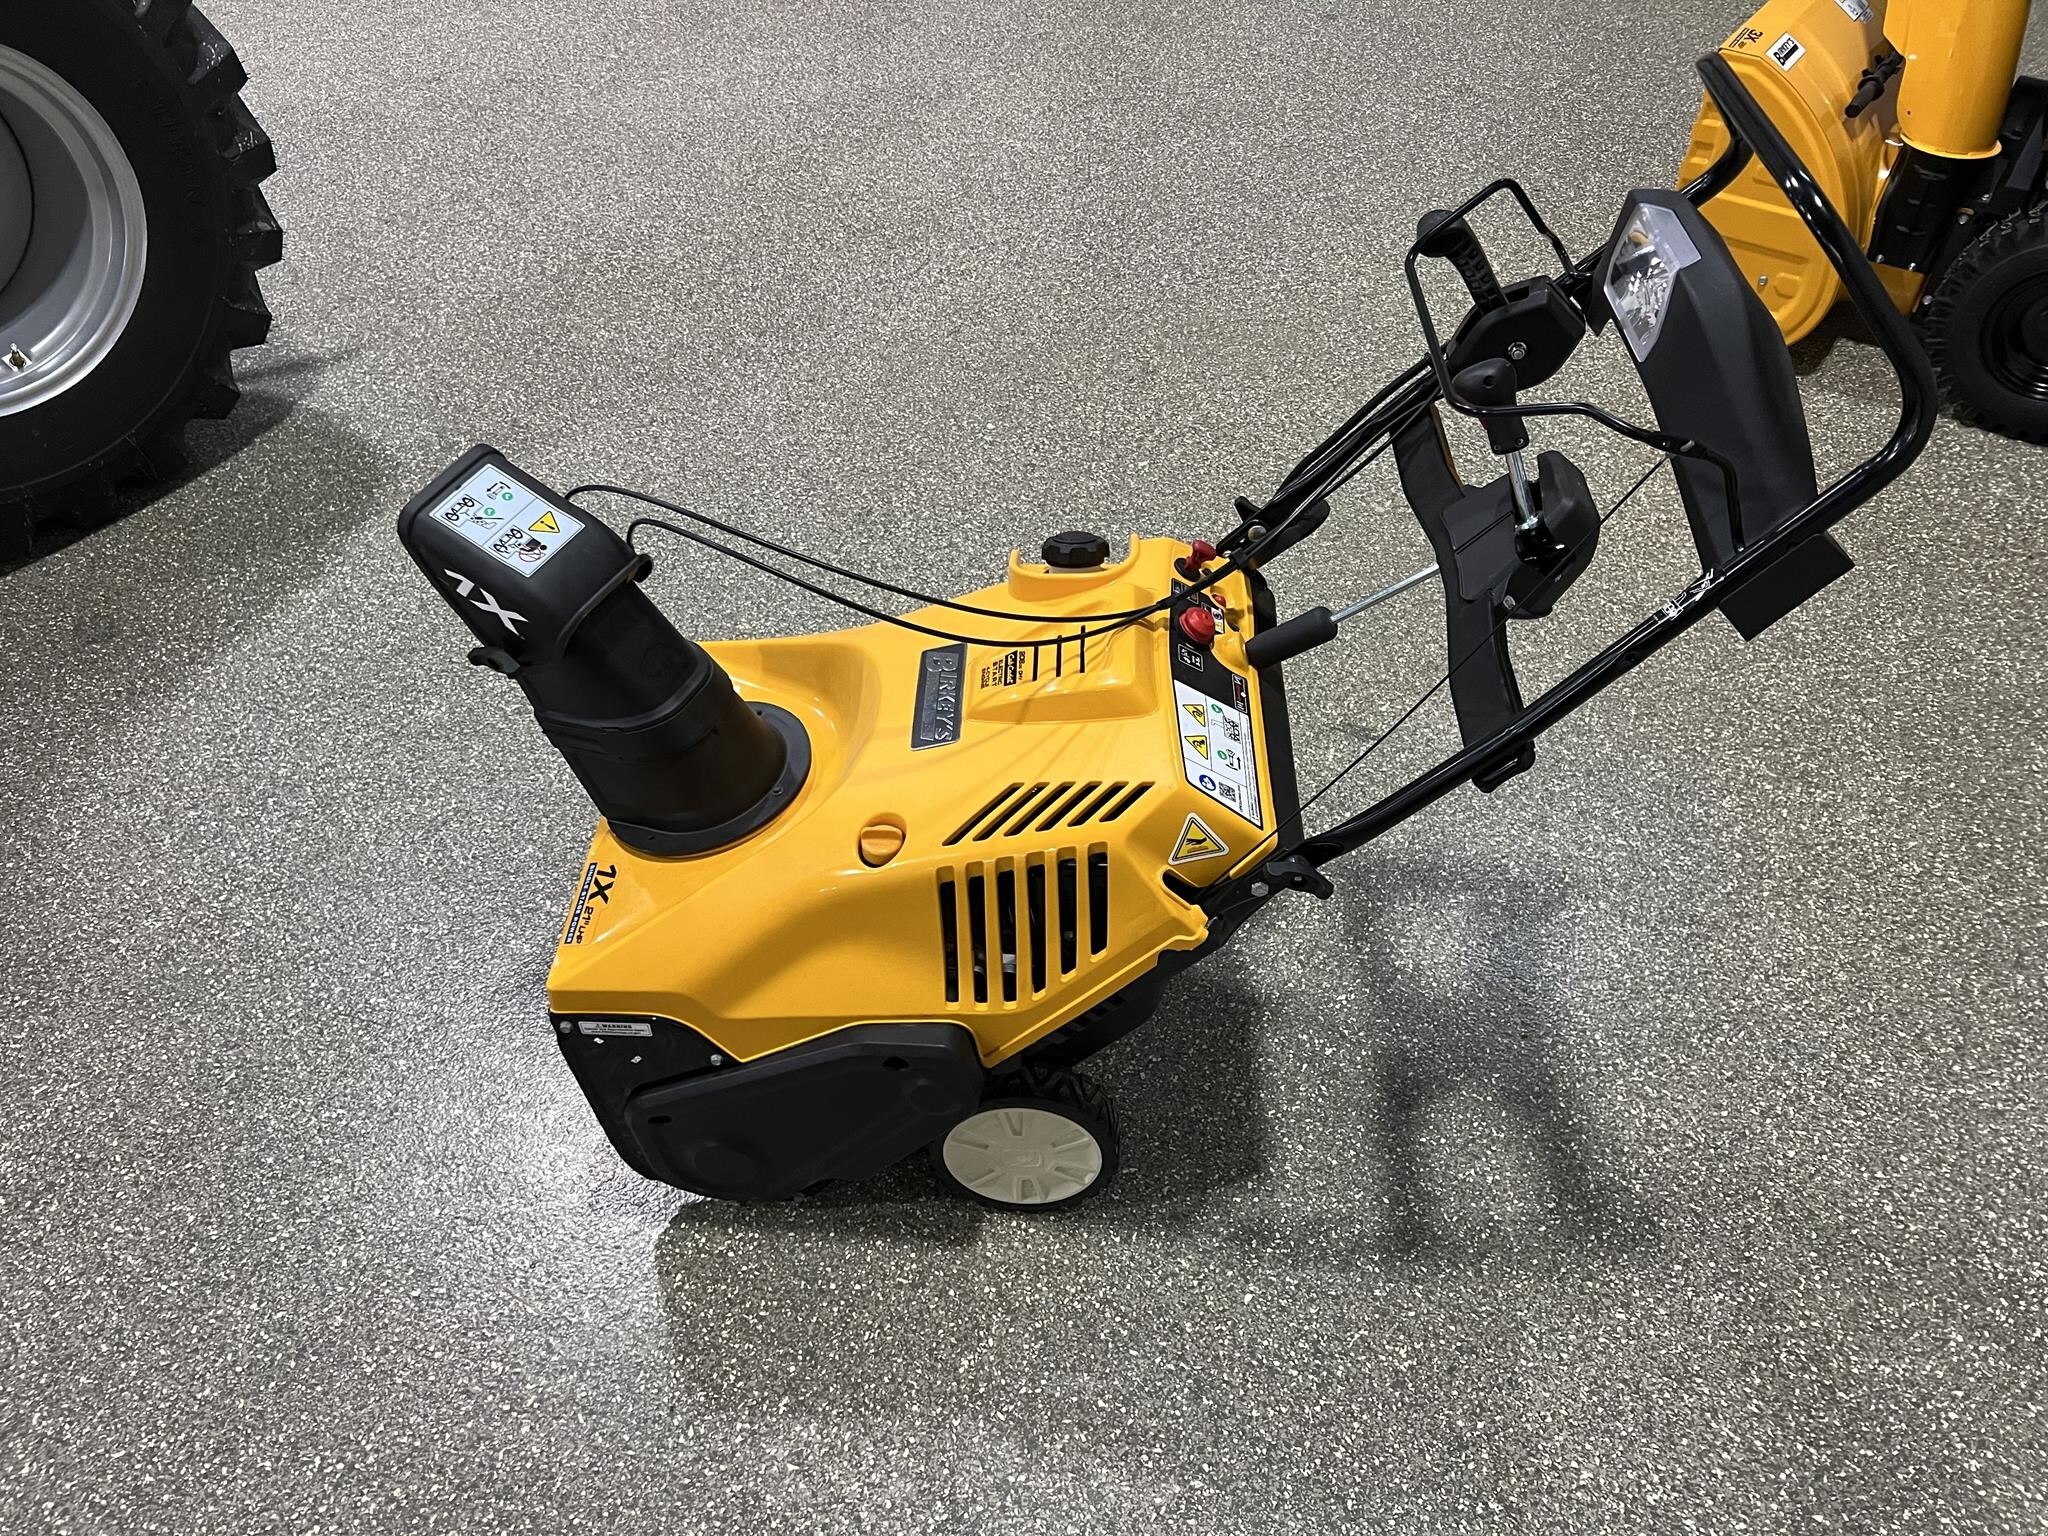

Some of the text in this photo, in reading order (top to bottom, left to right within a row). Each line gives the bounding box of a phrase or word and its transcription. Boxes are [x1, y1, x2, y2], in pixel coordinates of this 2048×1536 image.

[1744, 29, 1763, 43] 3X
[444, 568, 529, 639] 1X
[925, 652, 959, 740] BIRKEY'S
[566, 864, 595, 943] SINGLE STAGE POWER
[588, 864, 617, 905] 1X
